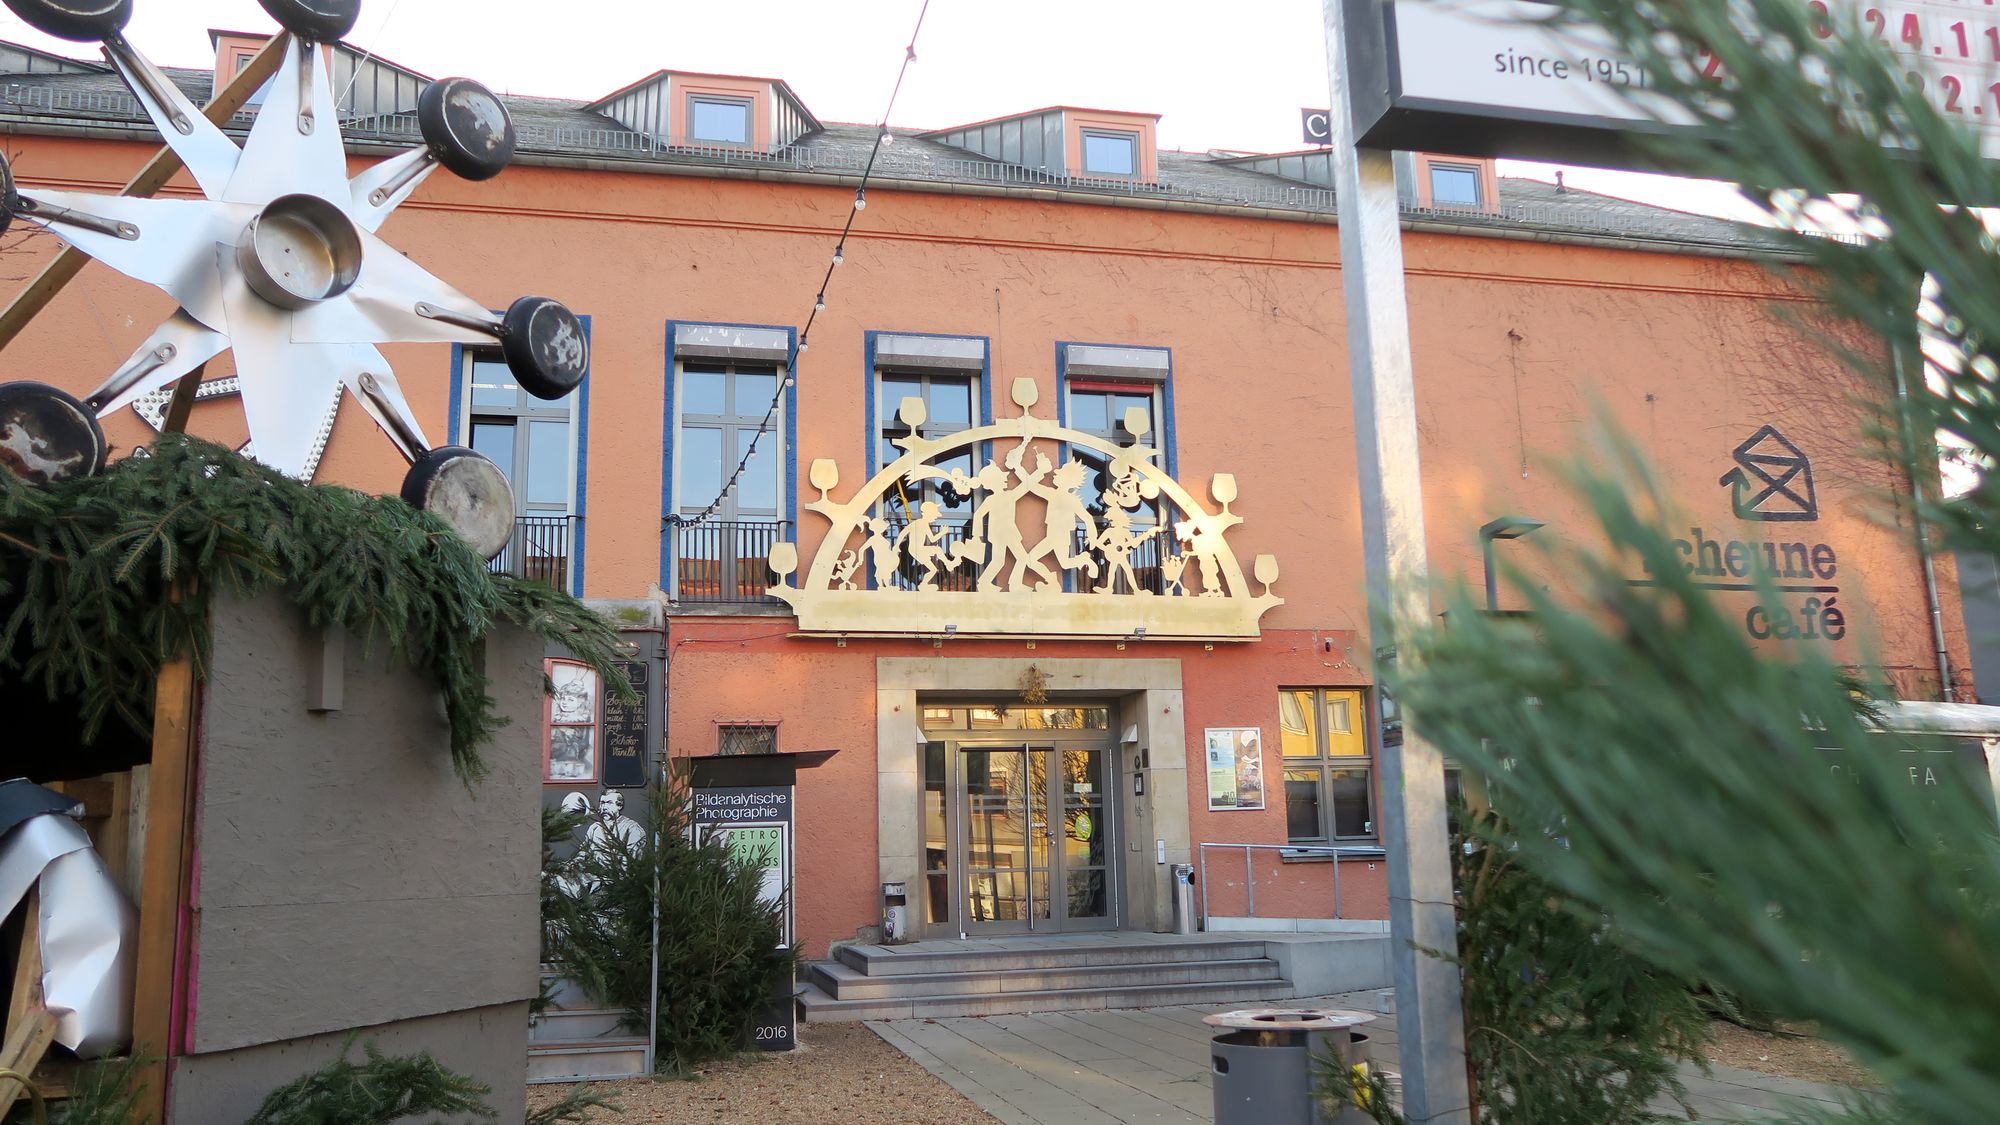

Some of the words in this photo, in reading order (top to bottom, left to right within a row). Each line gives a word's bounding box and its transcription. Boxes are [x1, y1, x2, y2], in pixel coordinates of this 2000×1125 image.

[1494, 47, 1569, 79] since
[1580, 57, 1647, 88] 1951
[1643, 527, 1837, 580] cheune
[1746, 597, 1846, 641] café
[695, 792, 786, 807] Bildanalytische
[695, 805, 778, 820] Photographie
[728, 829, 779, 840] RETRO
[755, 1025, 787, 1040] 2016
